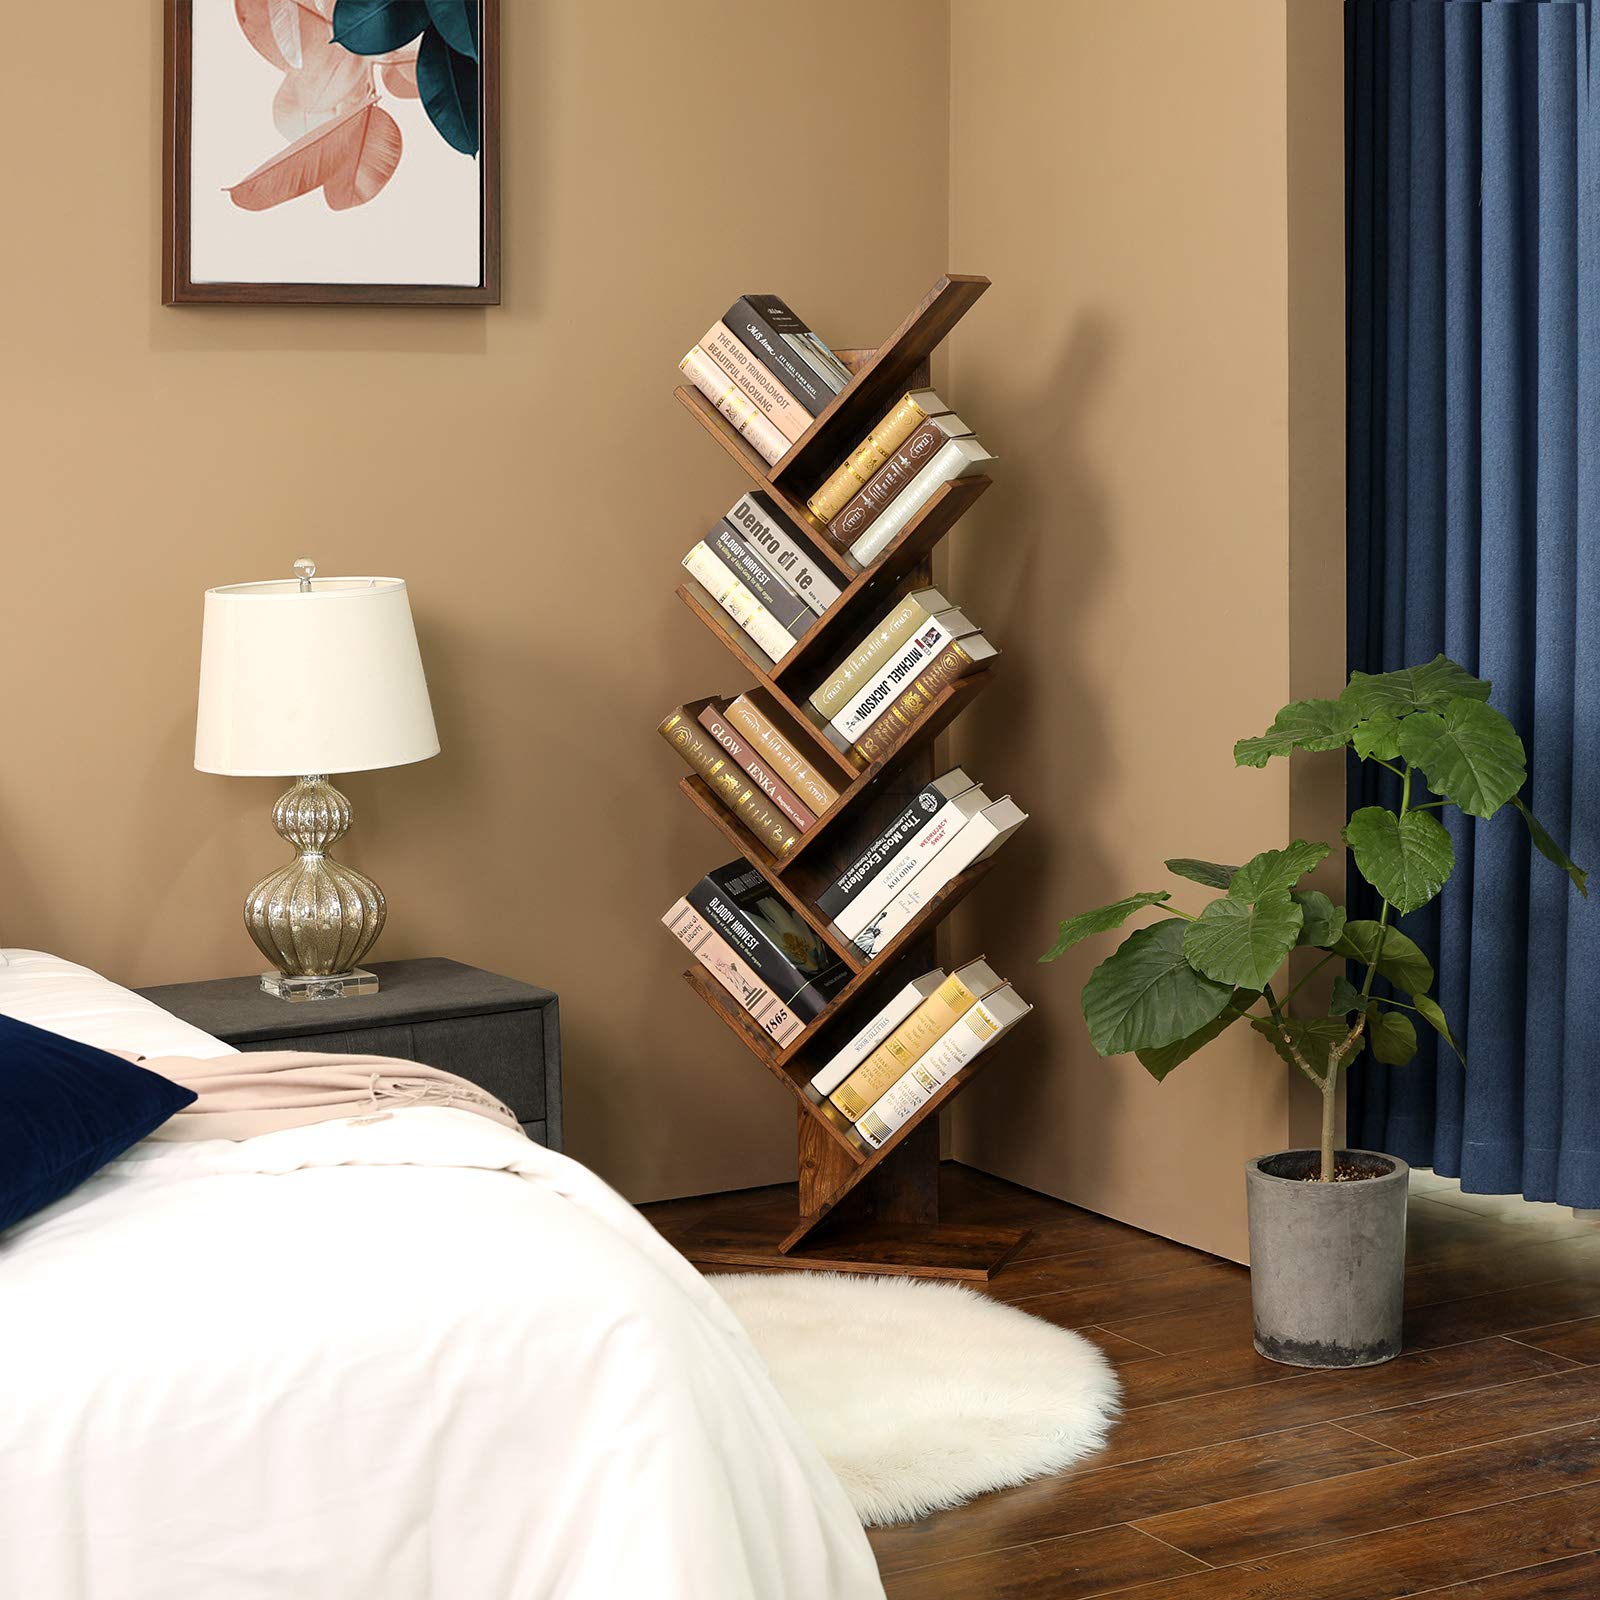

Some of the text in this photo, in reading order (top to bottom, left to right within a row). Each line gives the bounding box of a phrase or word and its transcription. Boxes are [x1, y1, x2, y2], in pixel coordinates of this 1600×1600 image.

[706, 342, 773, 412] BEAUTIFUL XIAOXIANG
[715, 331, 790, 409] THE BARD TRINIDADMOST
[911, 436, 931, 455] ITALY
[843, 509, 863, 529] ITALY
[715, 539, 723, 548] The
[719, 546, 732, 559] killing
[719, 531, 770, 585] BLOODY HARVEST
[731, 501, 816, 590] Dentro di te
[892, 610, 910, 629] ITALY
[886, 647, 923, 685] MICHAEL
[825, 682, 843, 700] ITALY
[854, 679, 893, 719] JACKSON
[745, 761, 779, 796] IENKA
[807, 784, 824, 801] ITALY
[836, 808, 914, 887] and Lamentable Tragedy of Romeo and Juliet
[839, 812, 921, 894] The Most Excellent
[676, 915, 698, 938] Statue of
[684, 923, 703, 943] Liberty
[708, 896, 735, 924] BLOODY
[729, 920, 759, 950] HARVEST
[763, 1008, 790, 1034] 1865
[867, 1017, 889, 1040] STILETTO
[854, 1037, 869, 1052] BOOK
